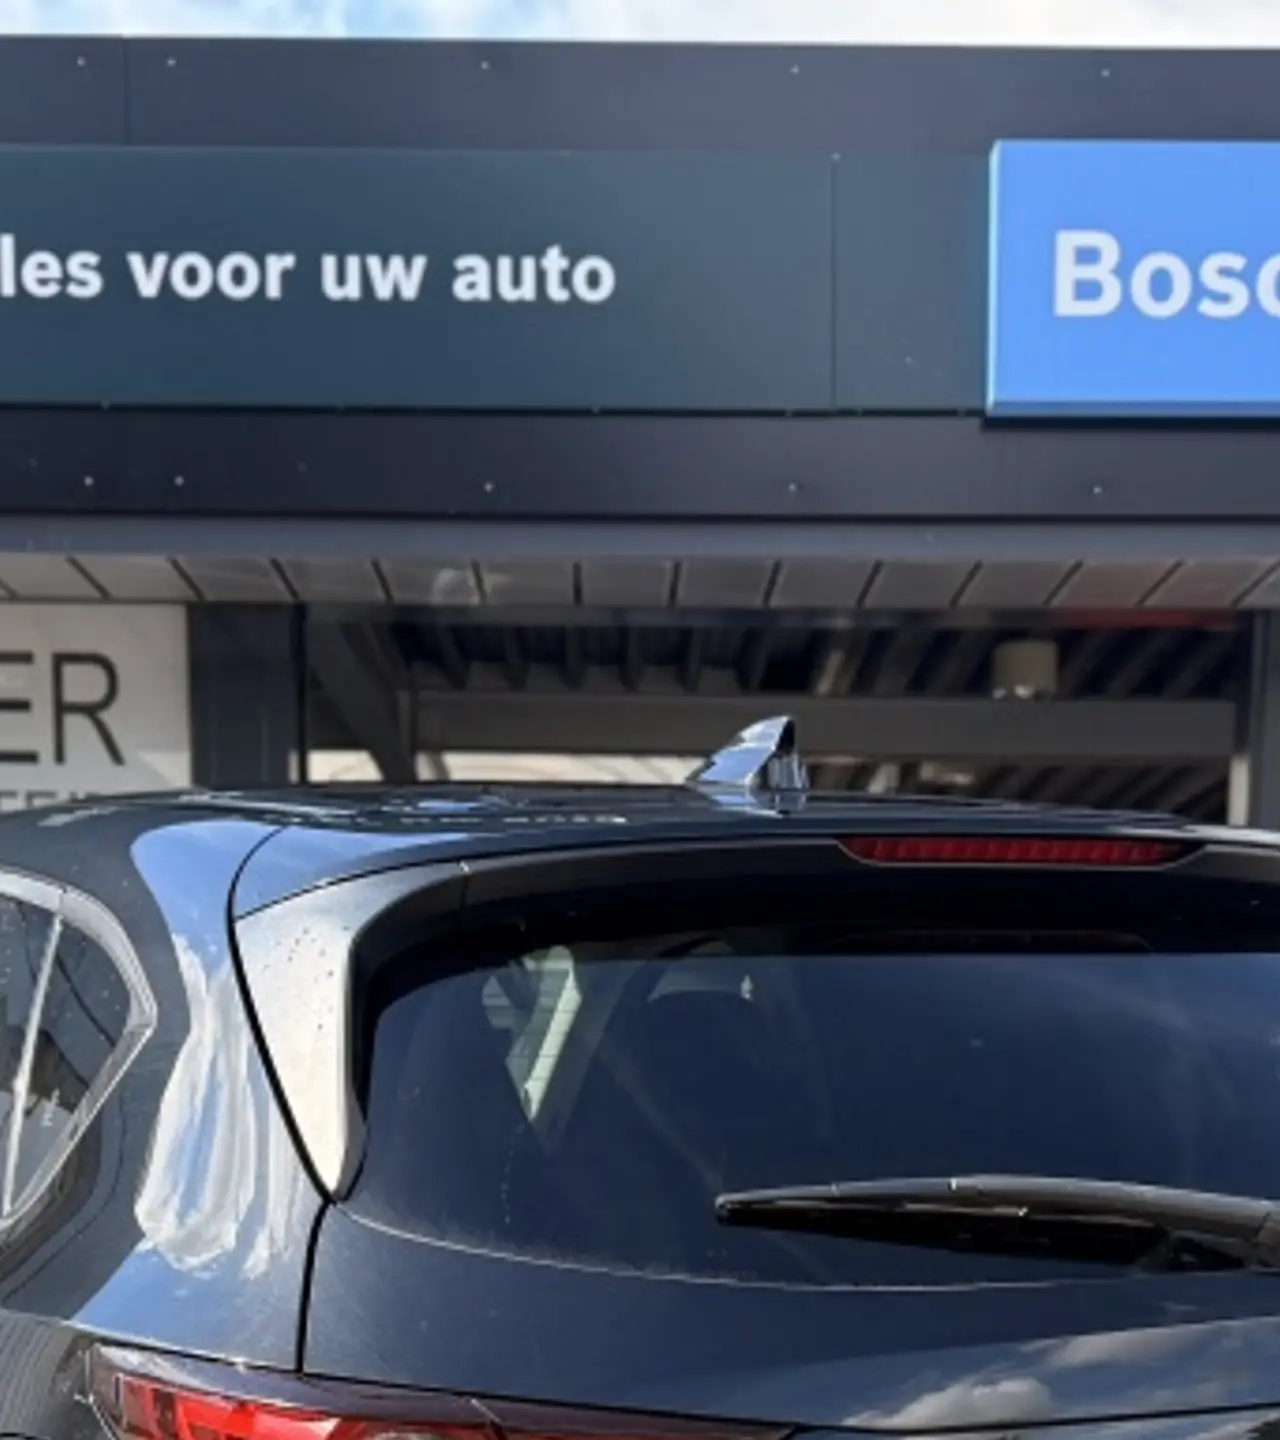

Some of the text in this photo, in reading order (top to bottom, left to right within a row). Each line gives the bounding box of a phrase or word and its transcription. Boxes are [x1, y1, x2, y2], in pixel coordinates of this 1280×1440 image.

[125, 248, 295, 300] voor
[320, 251, 426, 301] uw
[451, 244, 617, 304] auto
